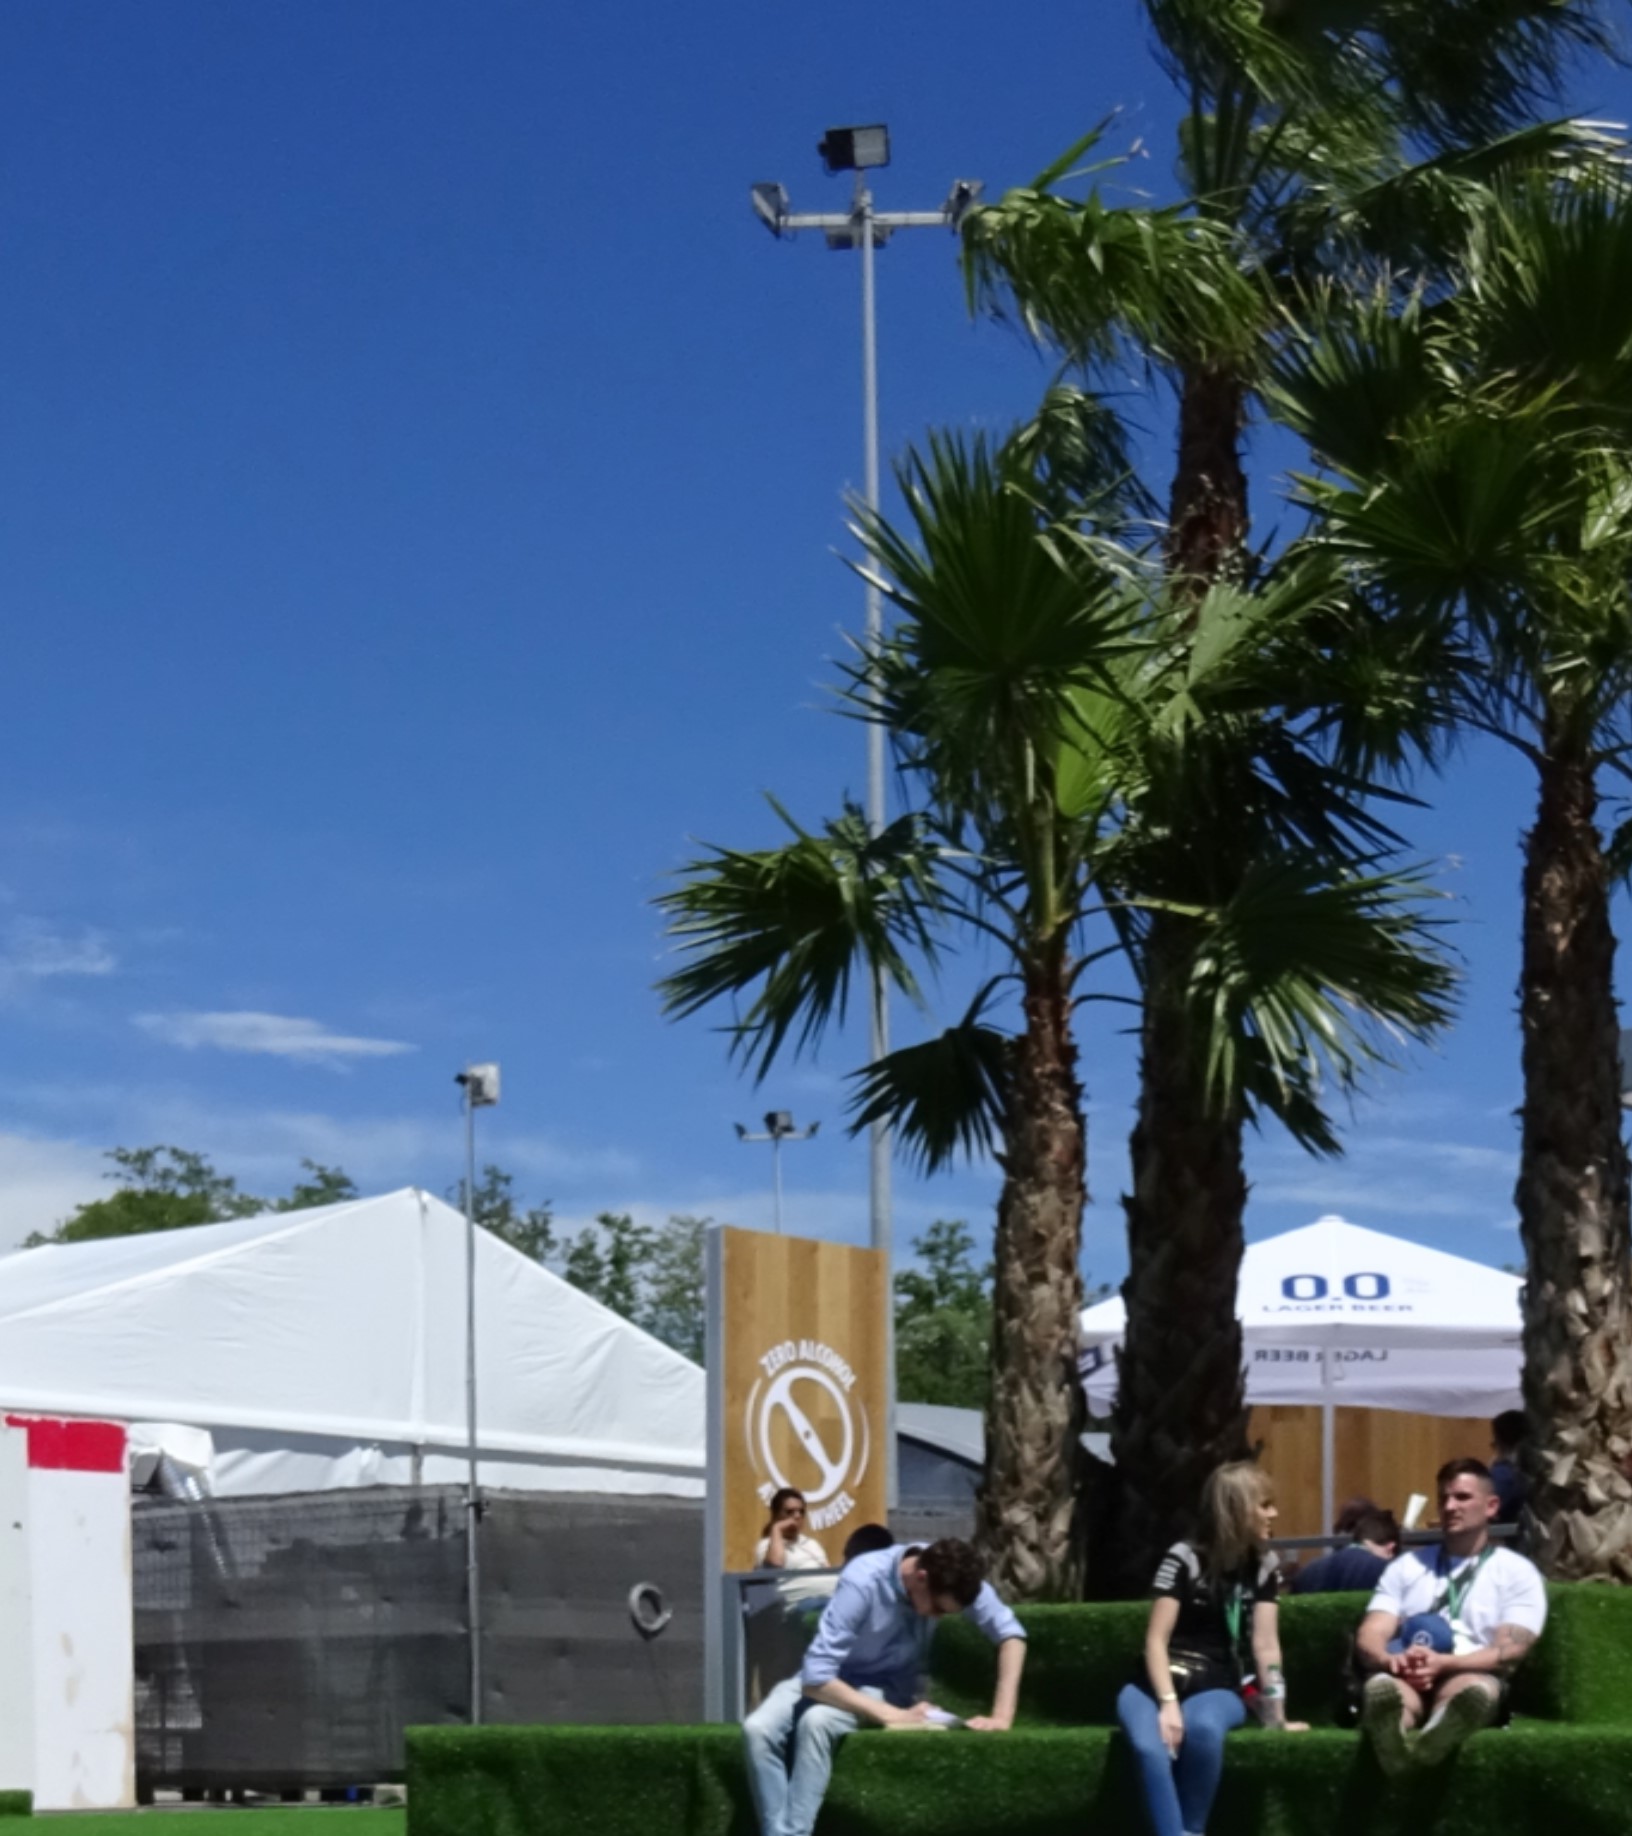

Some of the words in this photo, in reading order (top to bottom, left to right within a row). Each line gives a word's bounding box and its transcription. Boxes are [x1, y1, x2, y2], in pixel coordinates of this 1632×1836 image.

[1262, 1304, 1344, 1313] LAGER
[1351, 1304, 1414, 1313] BEER
[759, 1340, 796, 1378] ZERO
[799, 1339, 857, 1393] ALCOHOL
[807, 1491, 856, 1531] WHEEL
